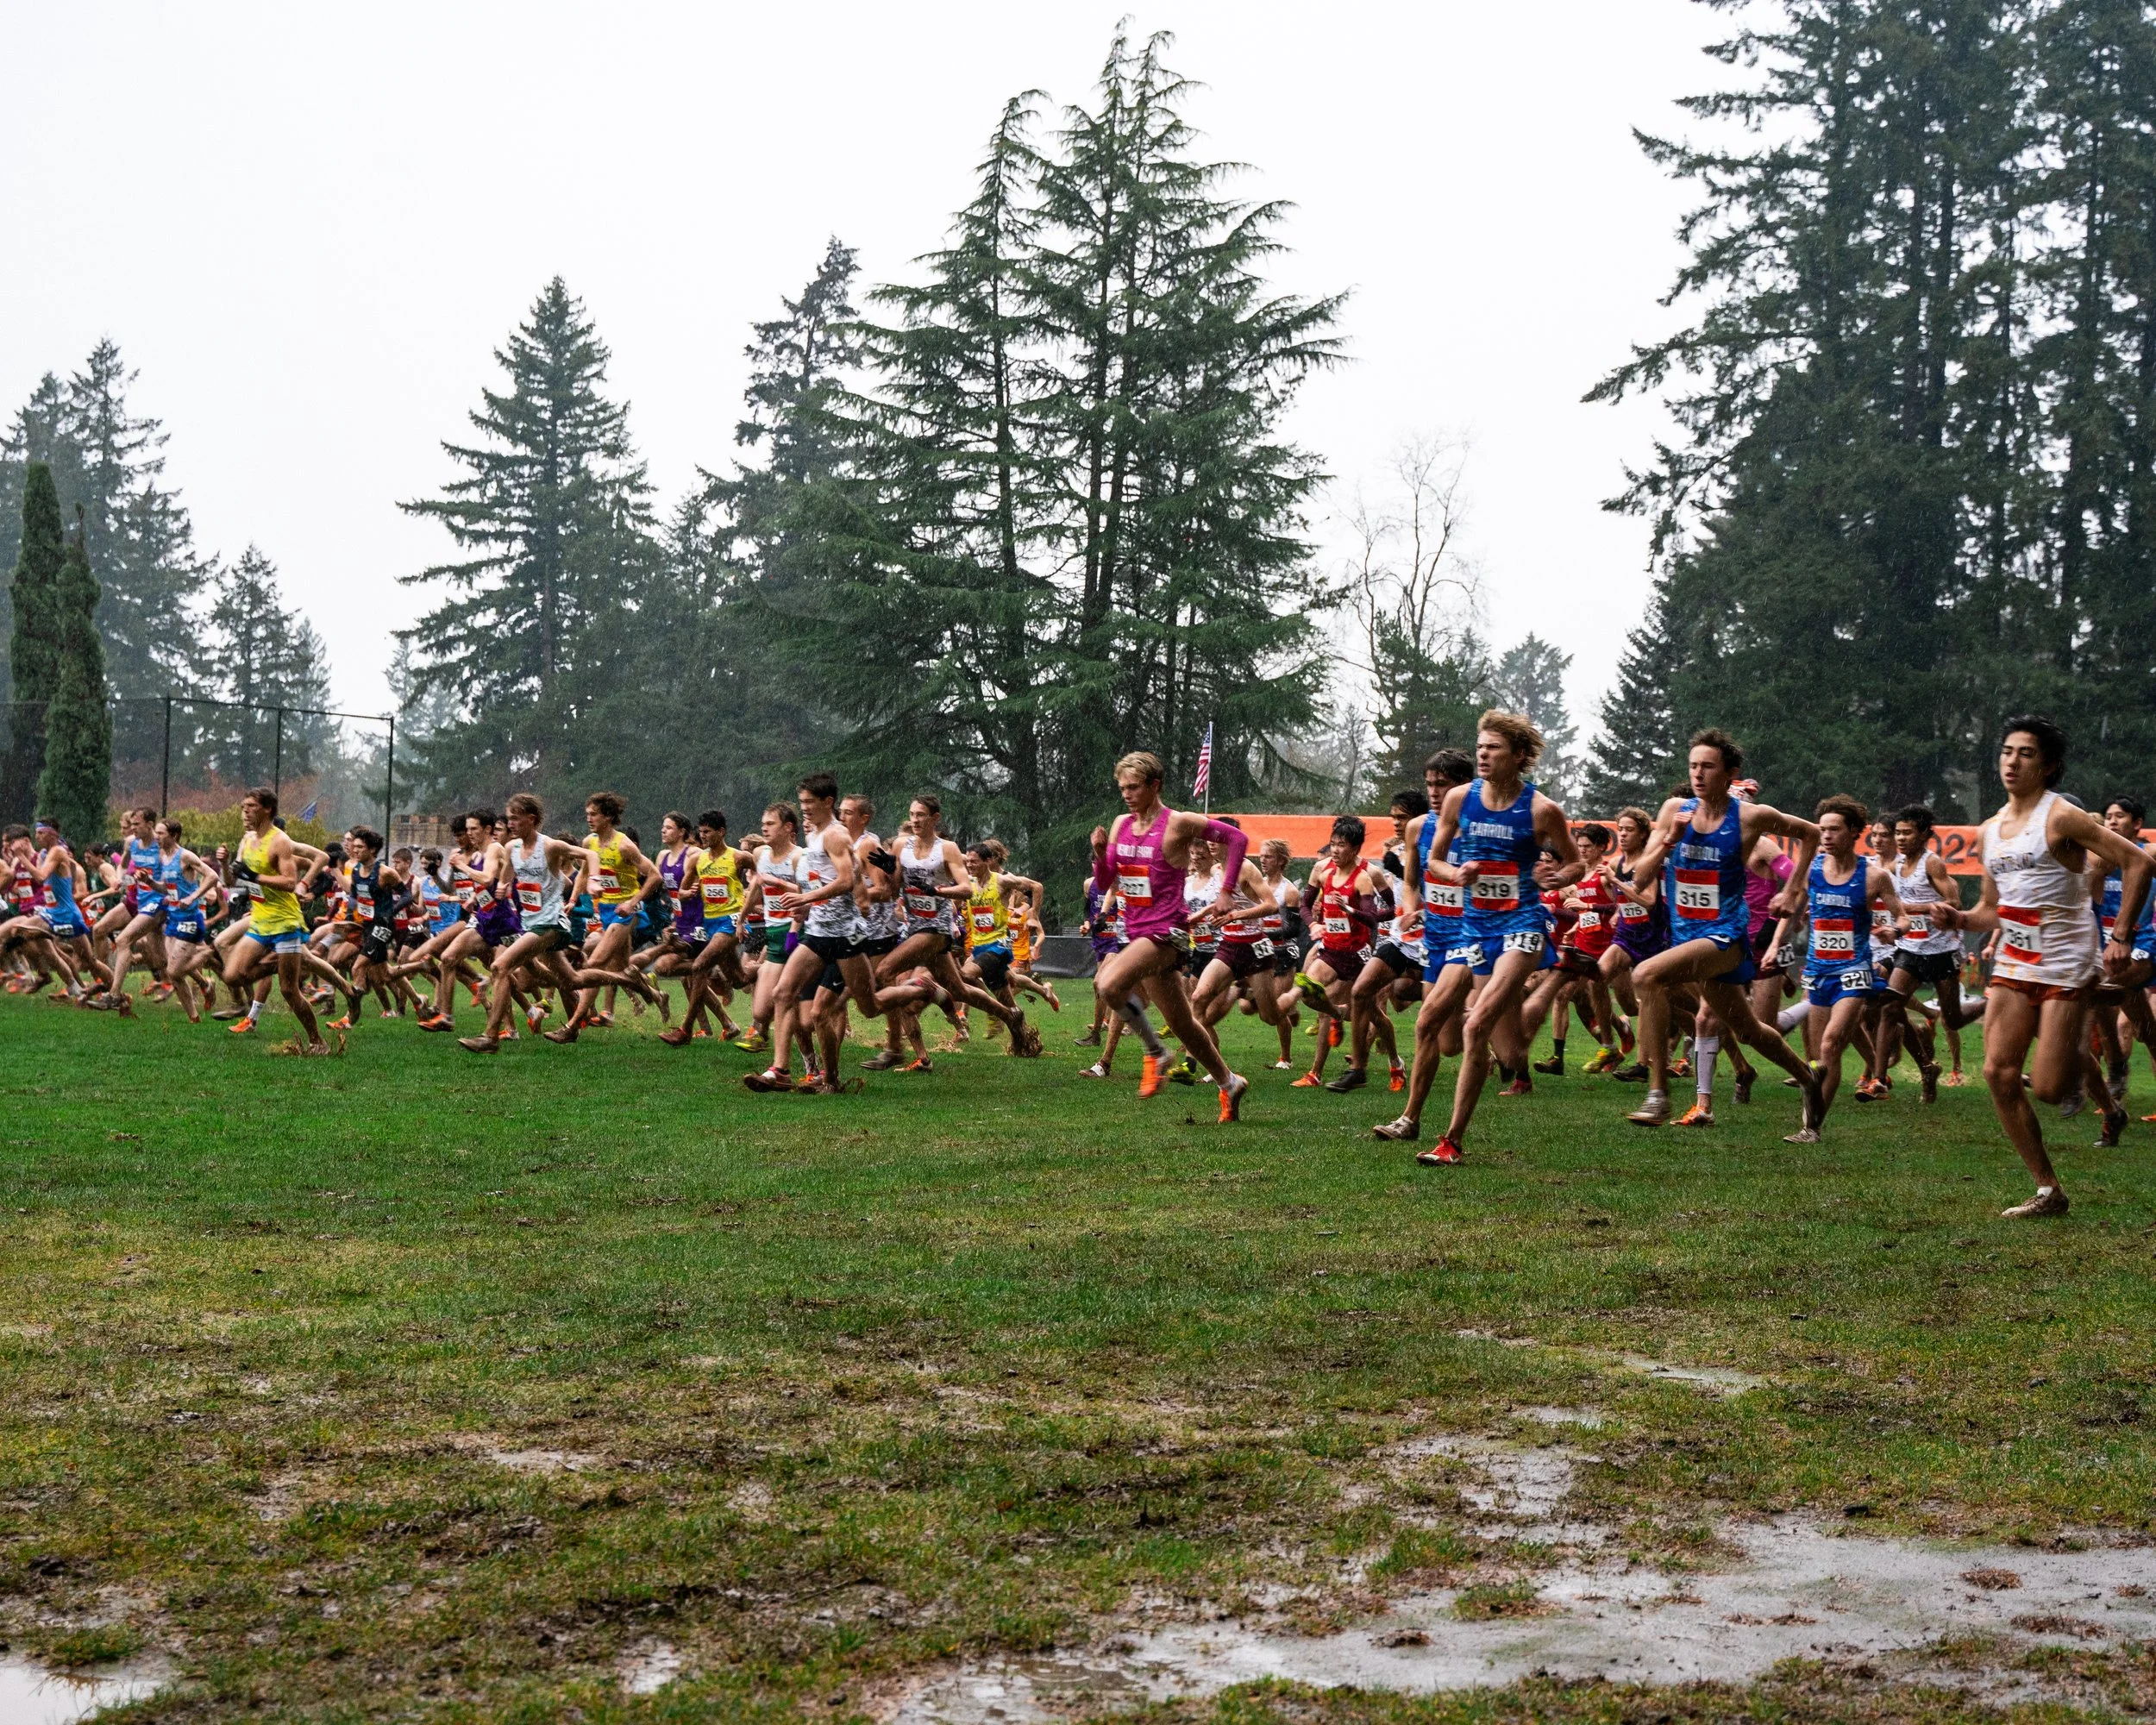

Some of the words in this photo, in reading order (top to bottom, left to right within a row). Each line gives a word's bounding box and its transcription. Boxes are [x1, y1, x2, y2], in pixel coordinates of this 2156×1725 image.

[1469, 821, 1514, 840] CARROLL
[706, 888, 724, 897] 256
[1430, 890, 1457, 906] 314
[1477, 882, 1511, 898] 319
[1679, 890, 1711, 907] 315
[1624, 906, 1643, 916] 275
[1328, 923, 1346, 932] 264
[1820, 937, 1848, 950] 320
[2006, 928, 2033, 950] 361
